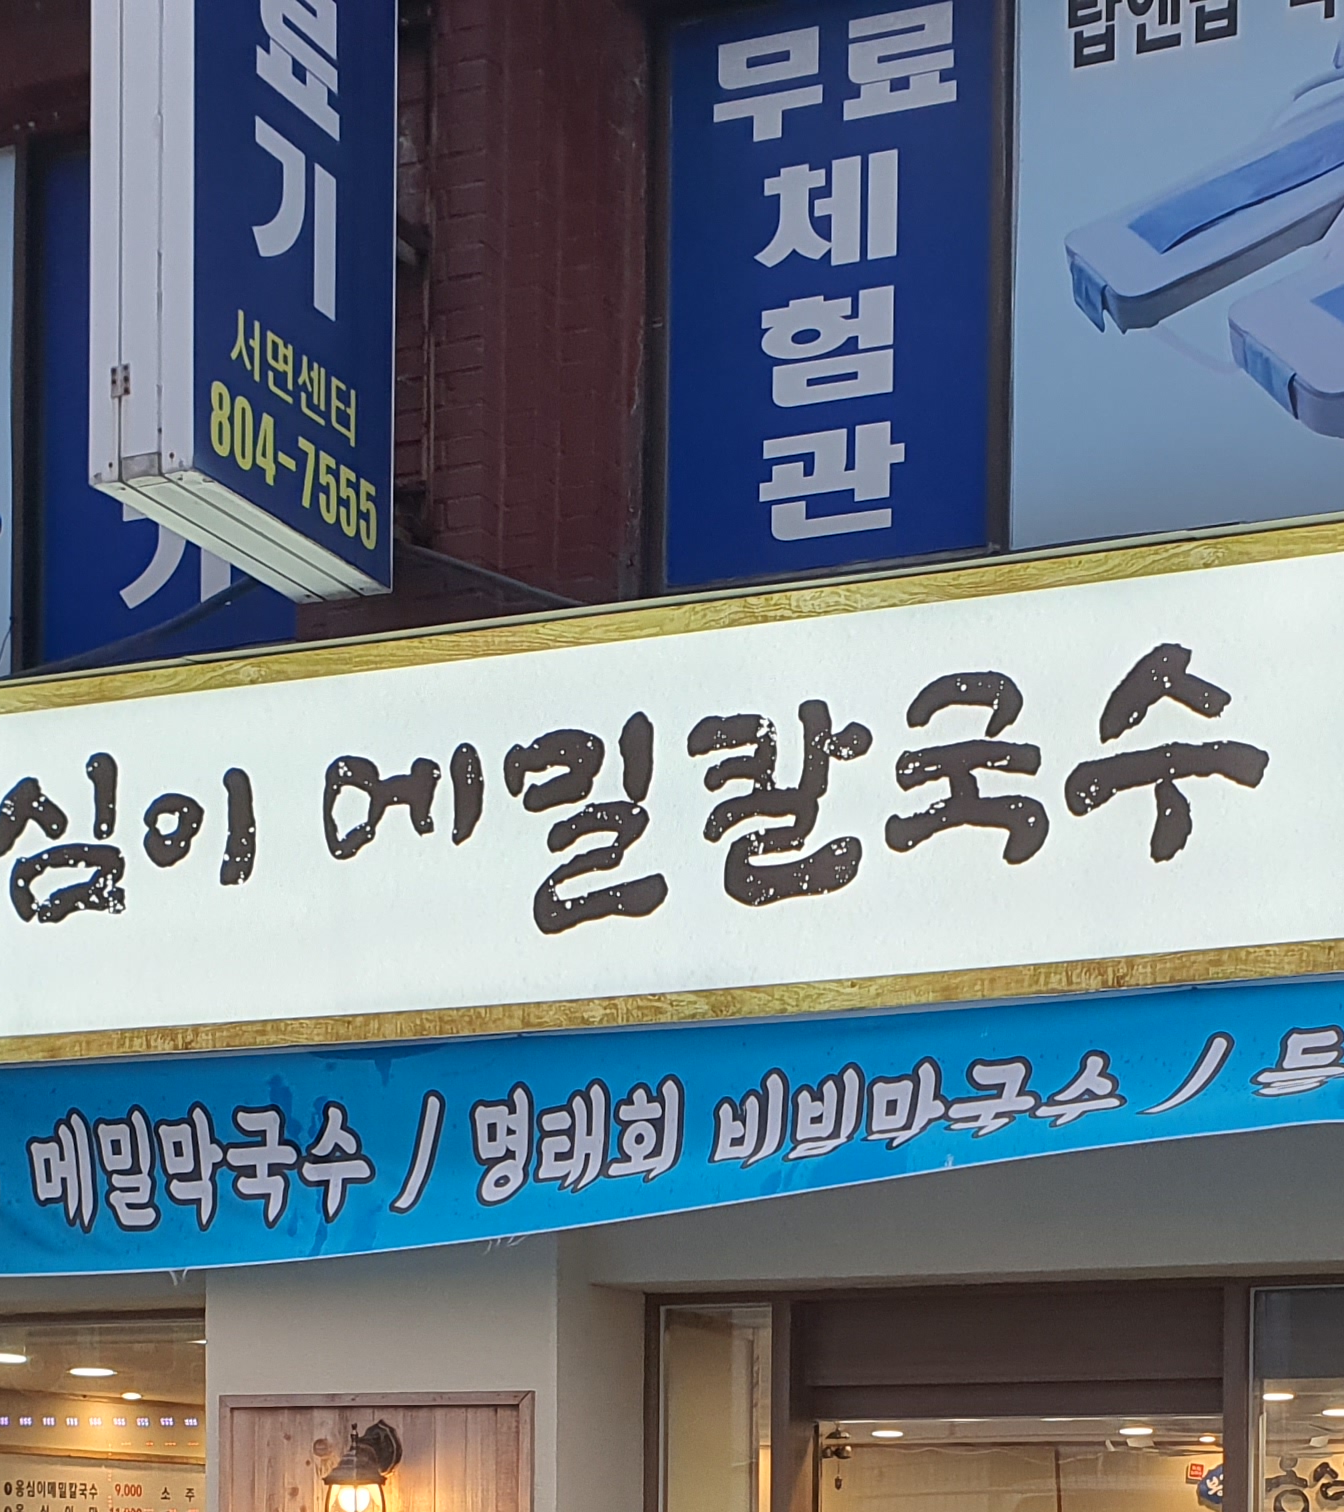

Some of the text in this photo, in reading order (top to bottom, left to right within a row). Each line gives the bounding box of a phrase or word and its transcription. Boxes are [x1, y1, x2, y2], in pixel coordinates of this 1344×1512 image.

[713, 1, 959, 142] 무료
[229, 307, 358, 448] 서면센터
[753, 148, 905, 541] 체험관
[208, 380, 378, 550] 804-7555
[323, 642, 1268, 934] 메밀칼국수
[27, 1101, 373, 1232] 메밀막국수
[471, 1074, 684, 1206] 명태회
[114, 1484, 142, 1497] 9,000
